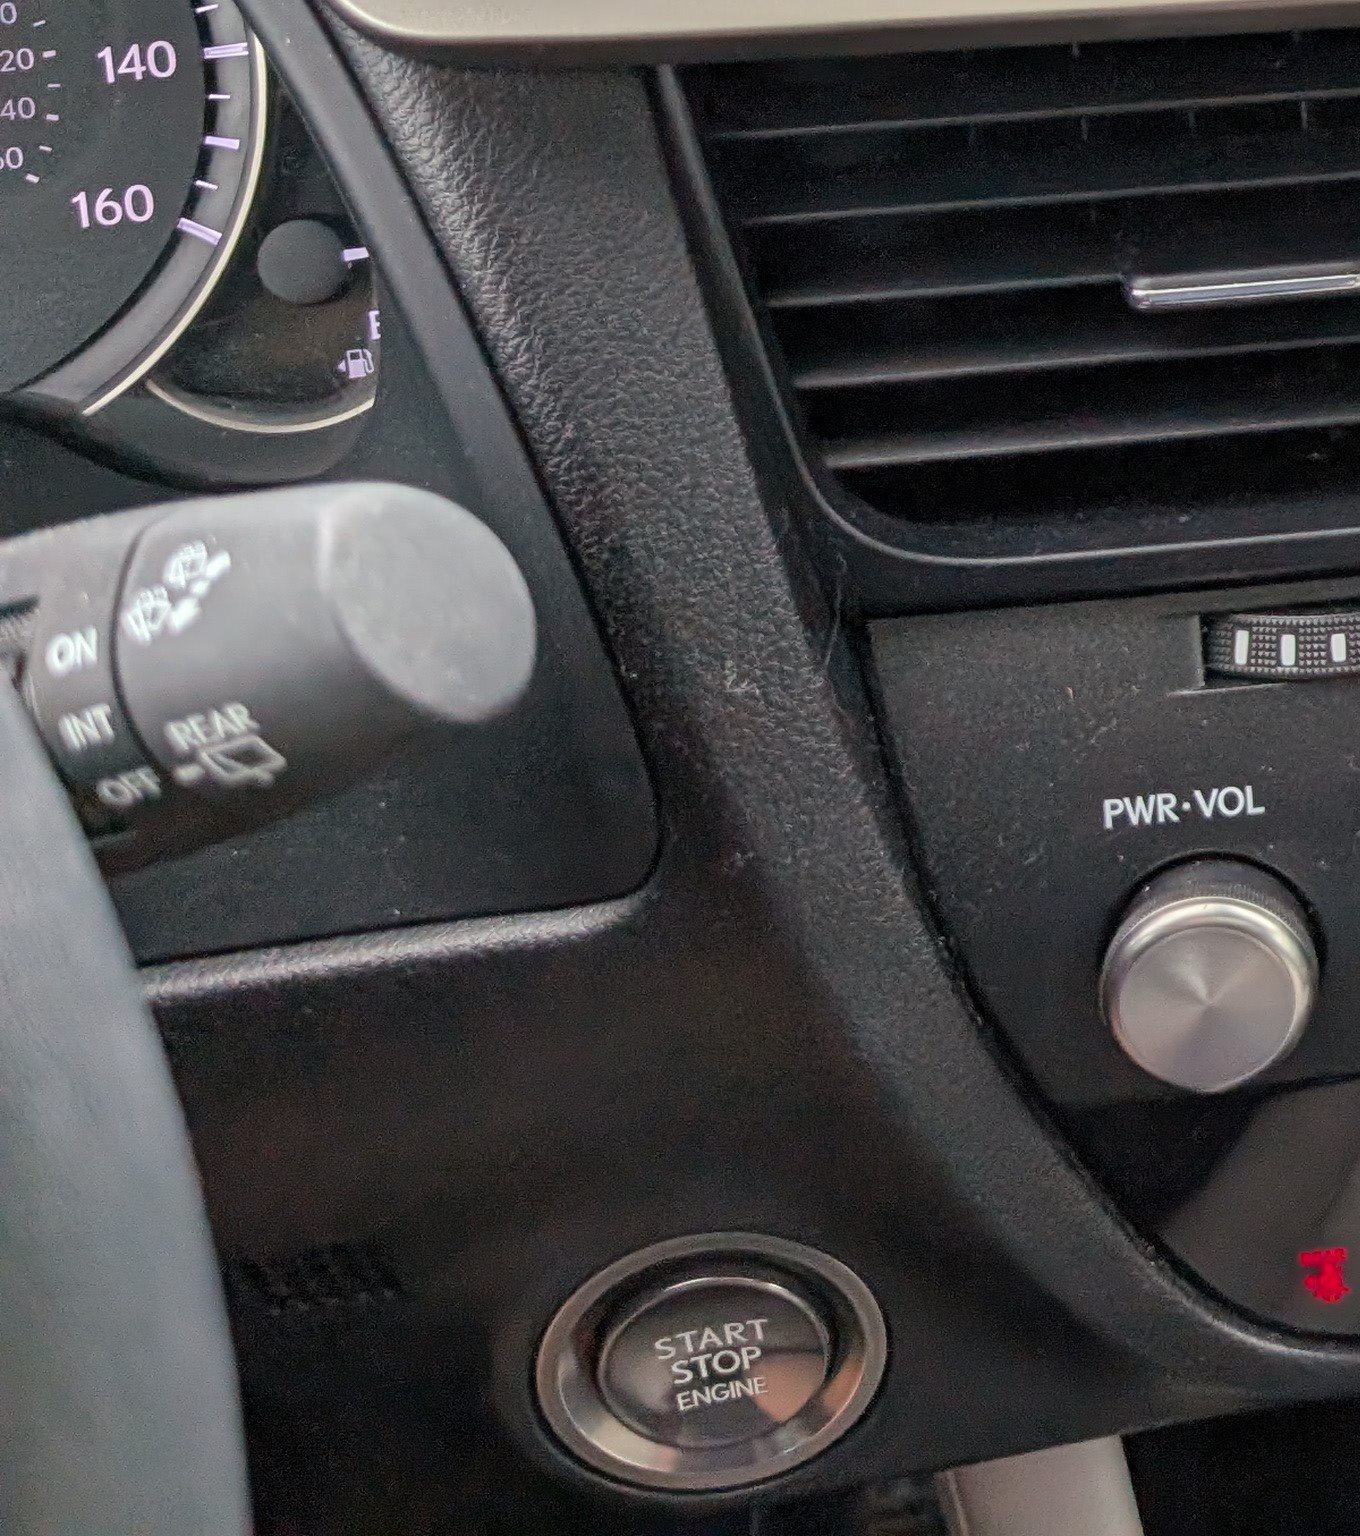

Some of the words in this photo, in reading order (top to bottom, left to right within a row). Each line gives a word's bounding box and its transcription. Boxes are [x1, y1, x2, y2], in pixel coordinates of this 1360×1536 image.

[96, 40, 177, 84] 140
[71, 184, 155, 230] 160
[46, 624, 97, 676] ON
[58, 703, 115, 752] INT
[164, 702, 260, 753] REAR
[97, 766, 162, 807] OFF
[654, 1318, 769, 1360] START
[671, 1346, 763, 1385] STOP
[676, 1376, 768, 1411] ENGINE
